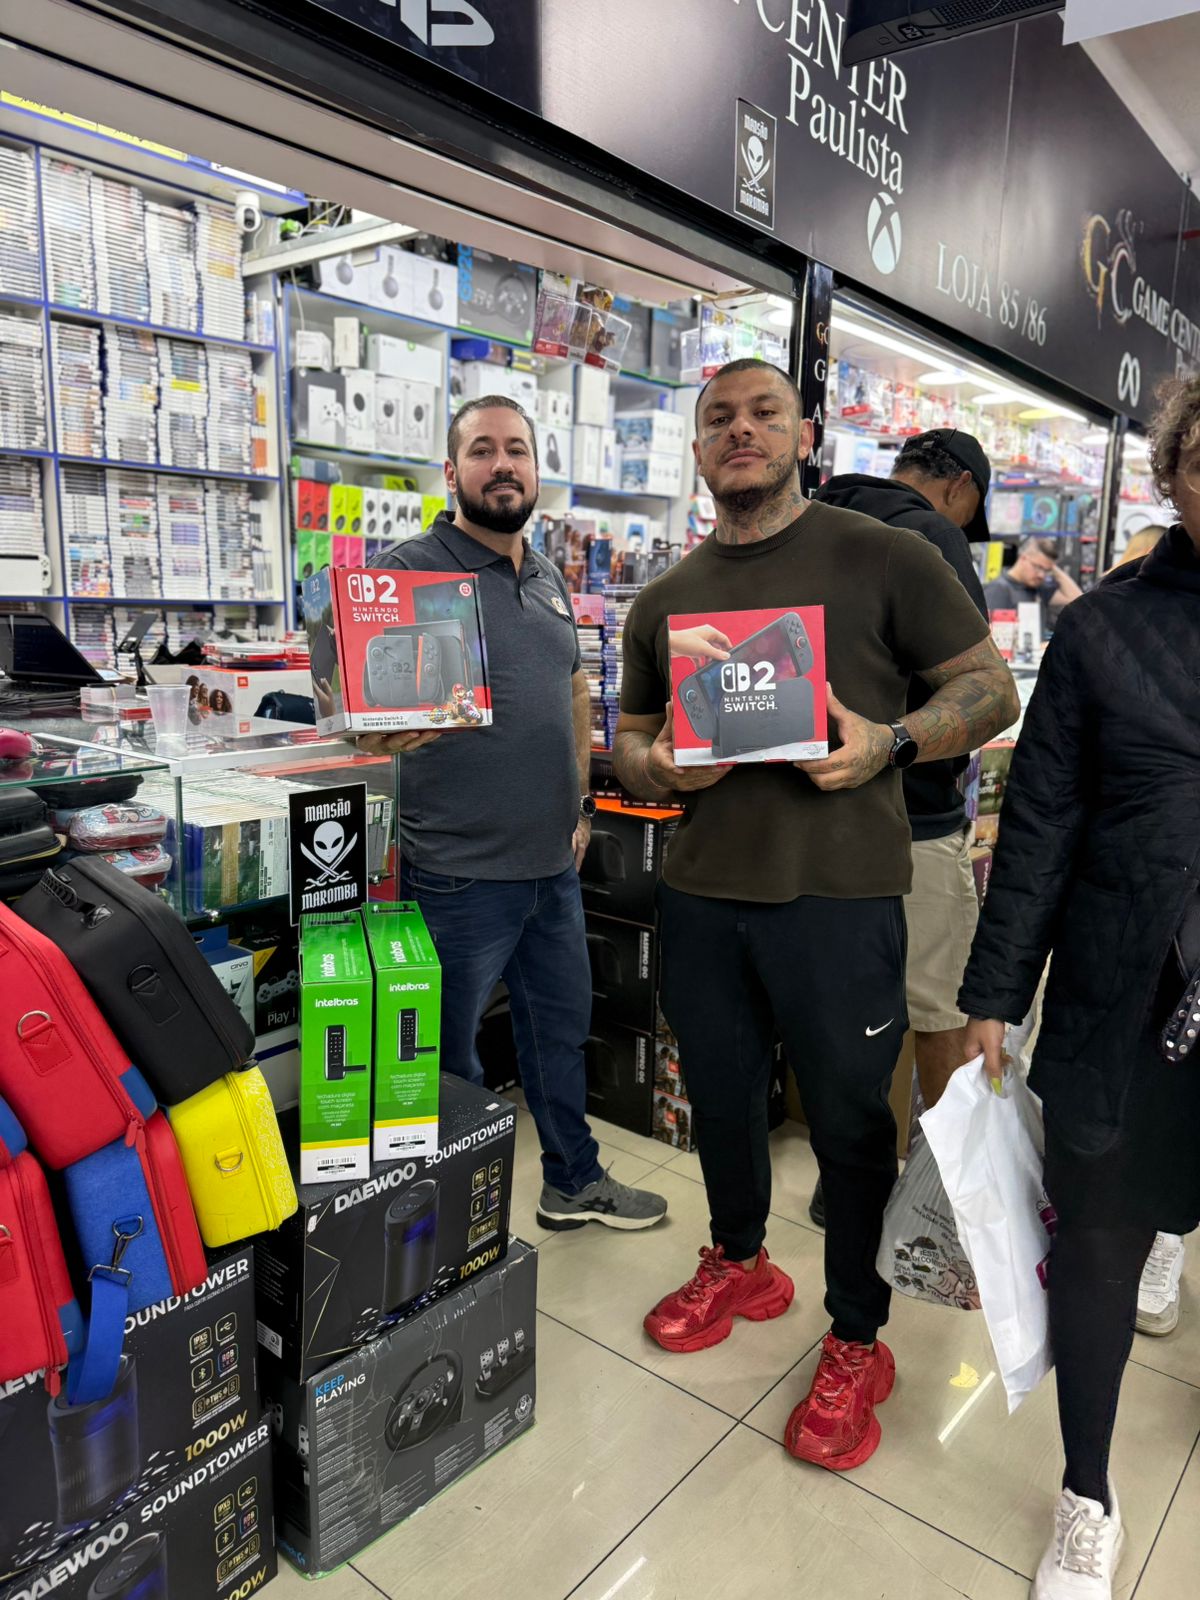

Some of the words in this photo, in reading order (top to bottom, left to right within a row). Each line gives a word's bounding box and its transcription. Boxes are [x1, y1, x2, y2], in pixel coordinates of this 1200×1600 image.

[786, 53, 904, 194] Paulista
[936, 242, 992, 319] LOJA
[1133, 277, 1172, 336] GAME
[353, 612, 399, 622] SWITCH
[724, 694, 775, 702] NINTENDO
[646, 823, 654, 856] BASSPRO
[645, 856, 653, 872] GO
[301, 883, 358, 911] MAROMBA
[389, 982, 430, 992] intelbras
[641, 963, 648, 979] GO
[267, 1009, 290, 1027] Play
[315, 998, 359, 1008] intelbras
[425, 1114, 514, 1168] SOUNDTOWER
[334, 1162, 417, 1214] DAEWOO
[459, 1243, 501, 1280] 1000W
[315, 1374, 345, 1397] KEEP
[315, 1373, 366, 1408] PLAYING
[184, 1410, 248, 1462] 1000W
[141, 1423, 270, 1524] SOUNDTOWER
